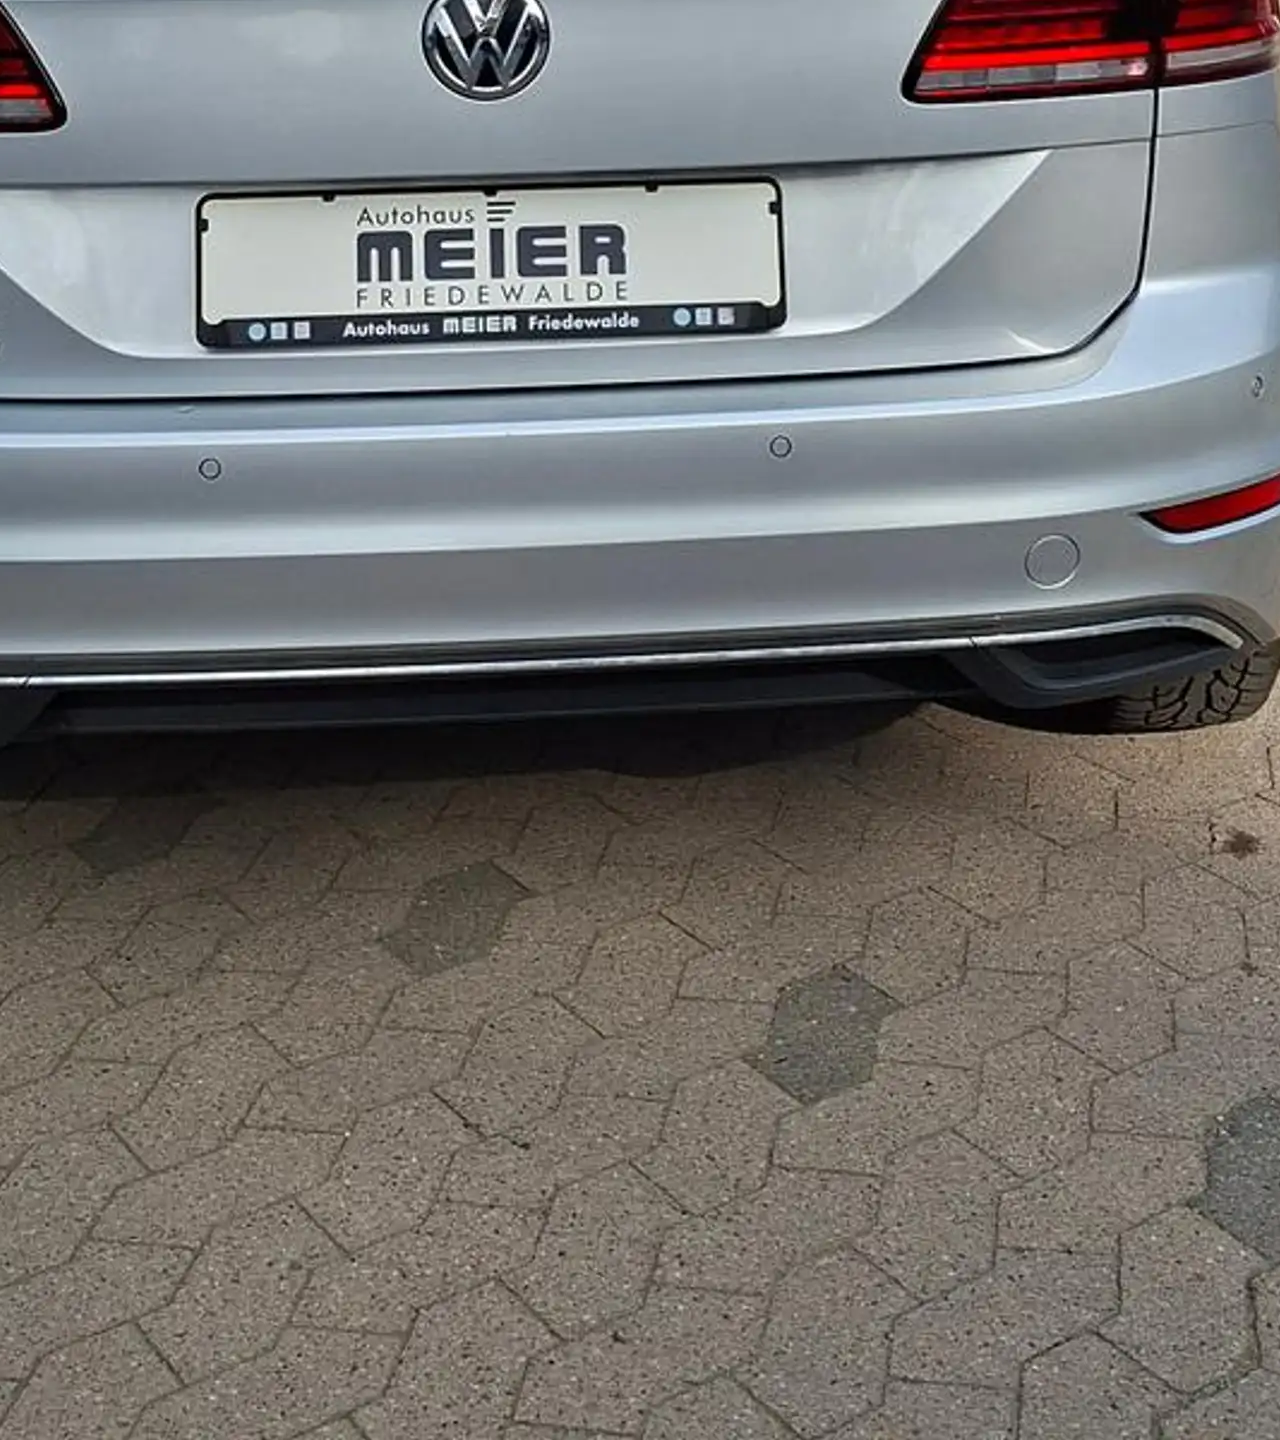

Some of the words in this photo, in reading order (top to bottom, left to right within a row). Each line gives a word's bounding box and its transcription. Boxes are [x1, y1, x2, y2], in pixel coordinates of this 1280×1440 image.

[356, 205, 475, 226] Autohaus
[356, 224, 627, 282] MEIER
[356, 280, 628, 308] FRIEDEWALDE
[342, 320, 430, 338] Autohaus
[442, 315, 517, 334] MEIER
[528, 311, 640, 331] Friedewalde
